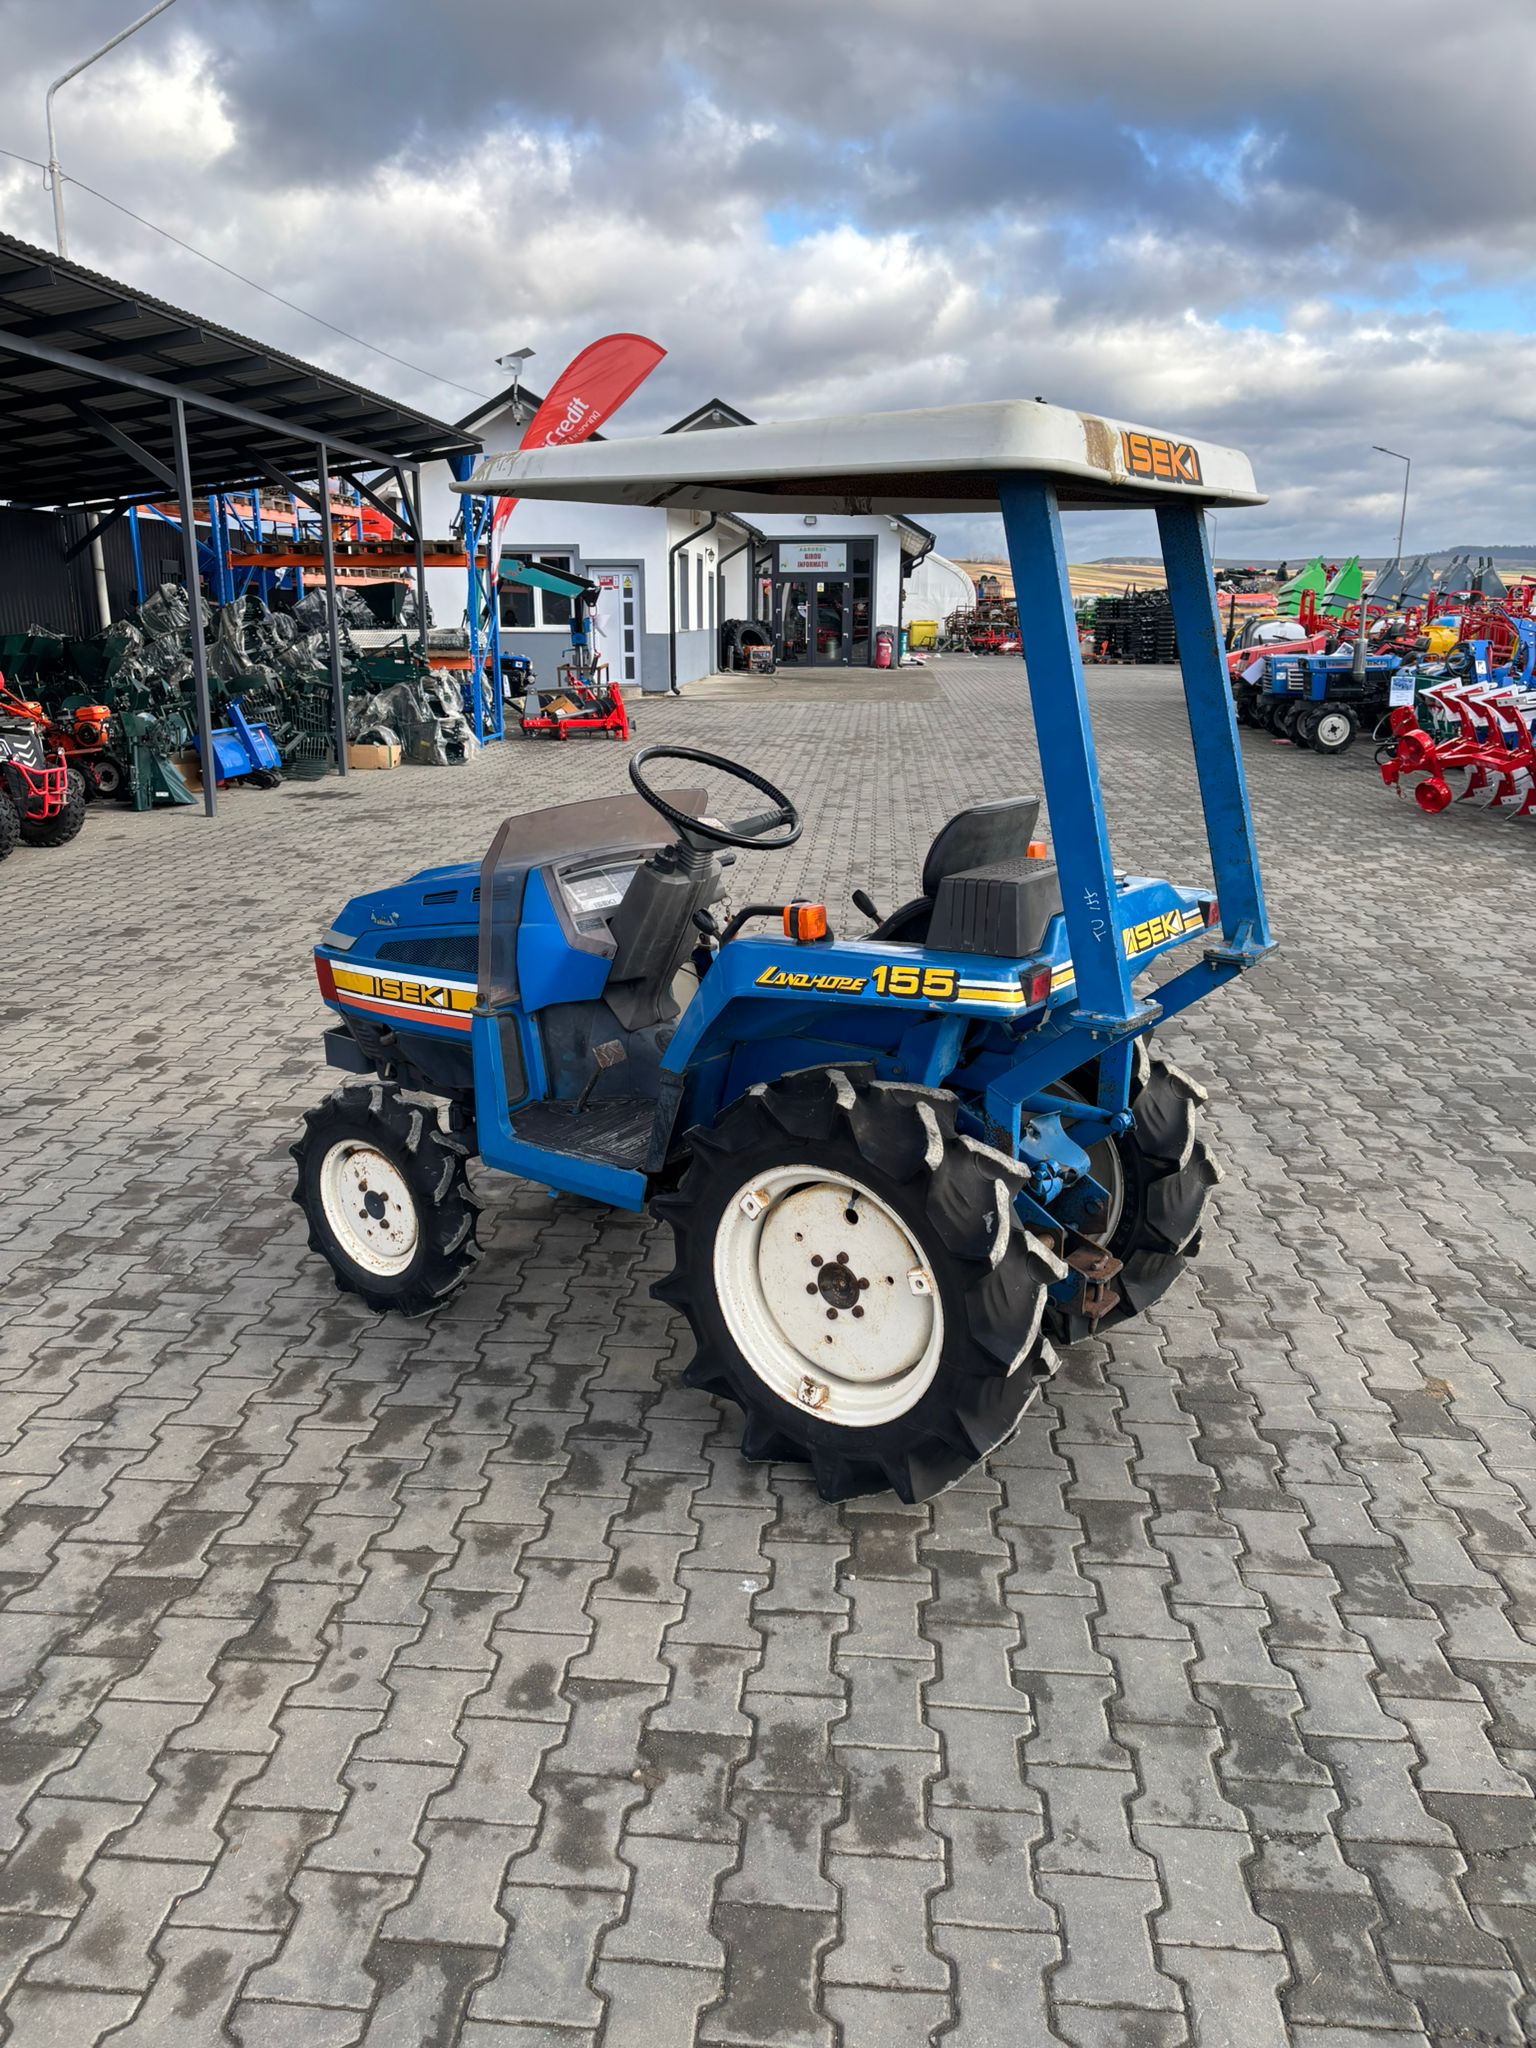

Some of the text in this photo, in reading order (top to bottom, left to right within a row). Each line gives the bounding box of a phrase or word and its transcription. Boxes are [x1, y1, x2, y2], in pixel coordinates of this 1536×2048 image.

[1120, 430, 1203, 484] ISEKI
[1124, 908, 1186, 955] ISEKI
[373, 976, 452, 1010] ISEKI
[872, 964, 960, 1002] 155
